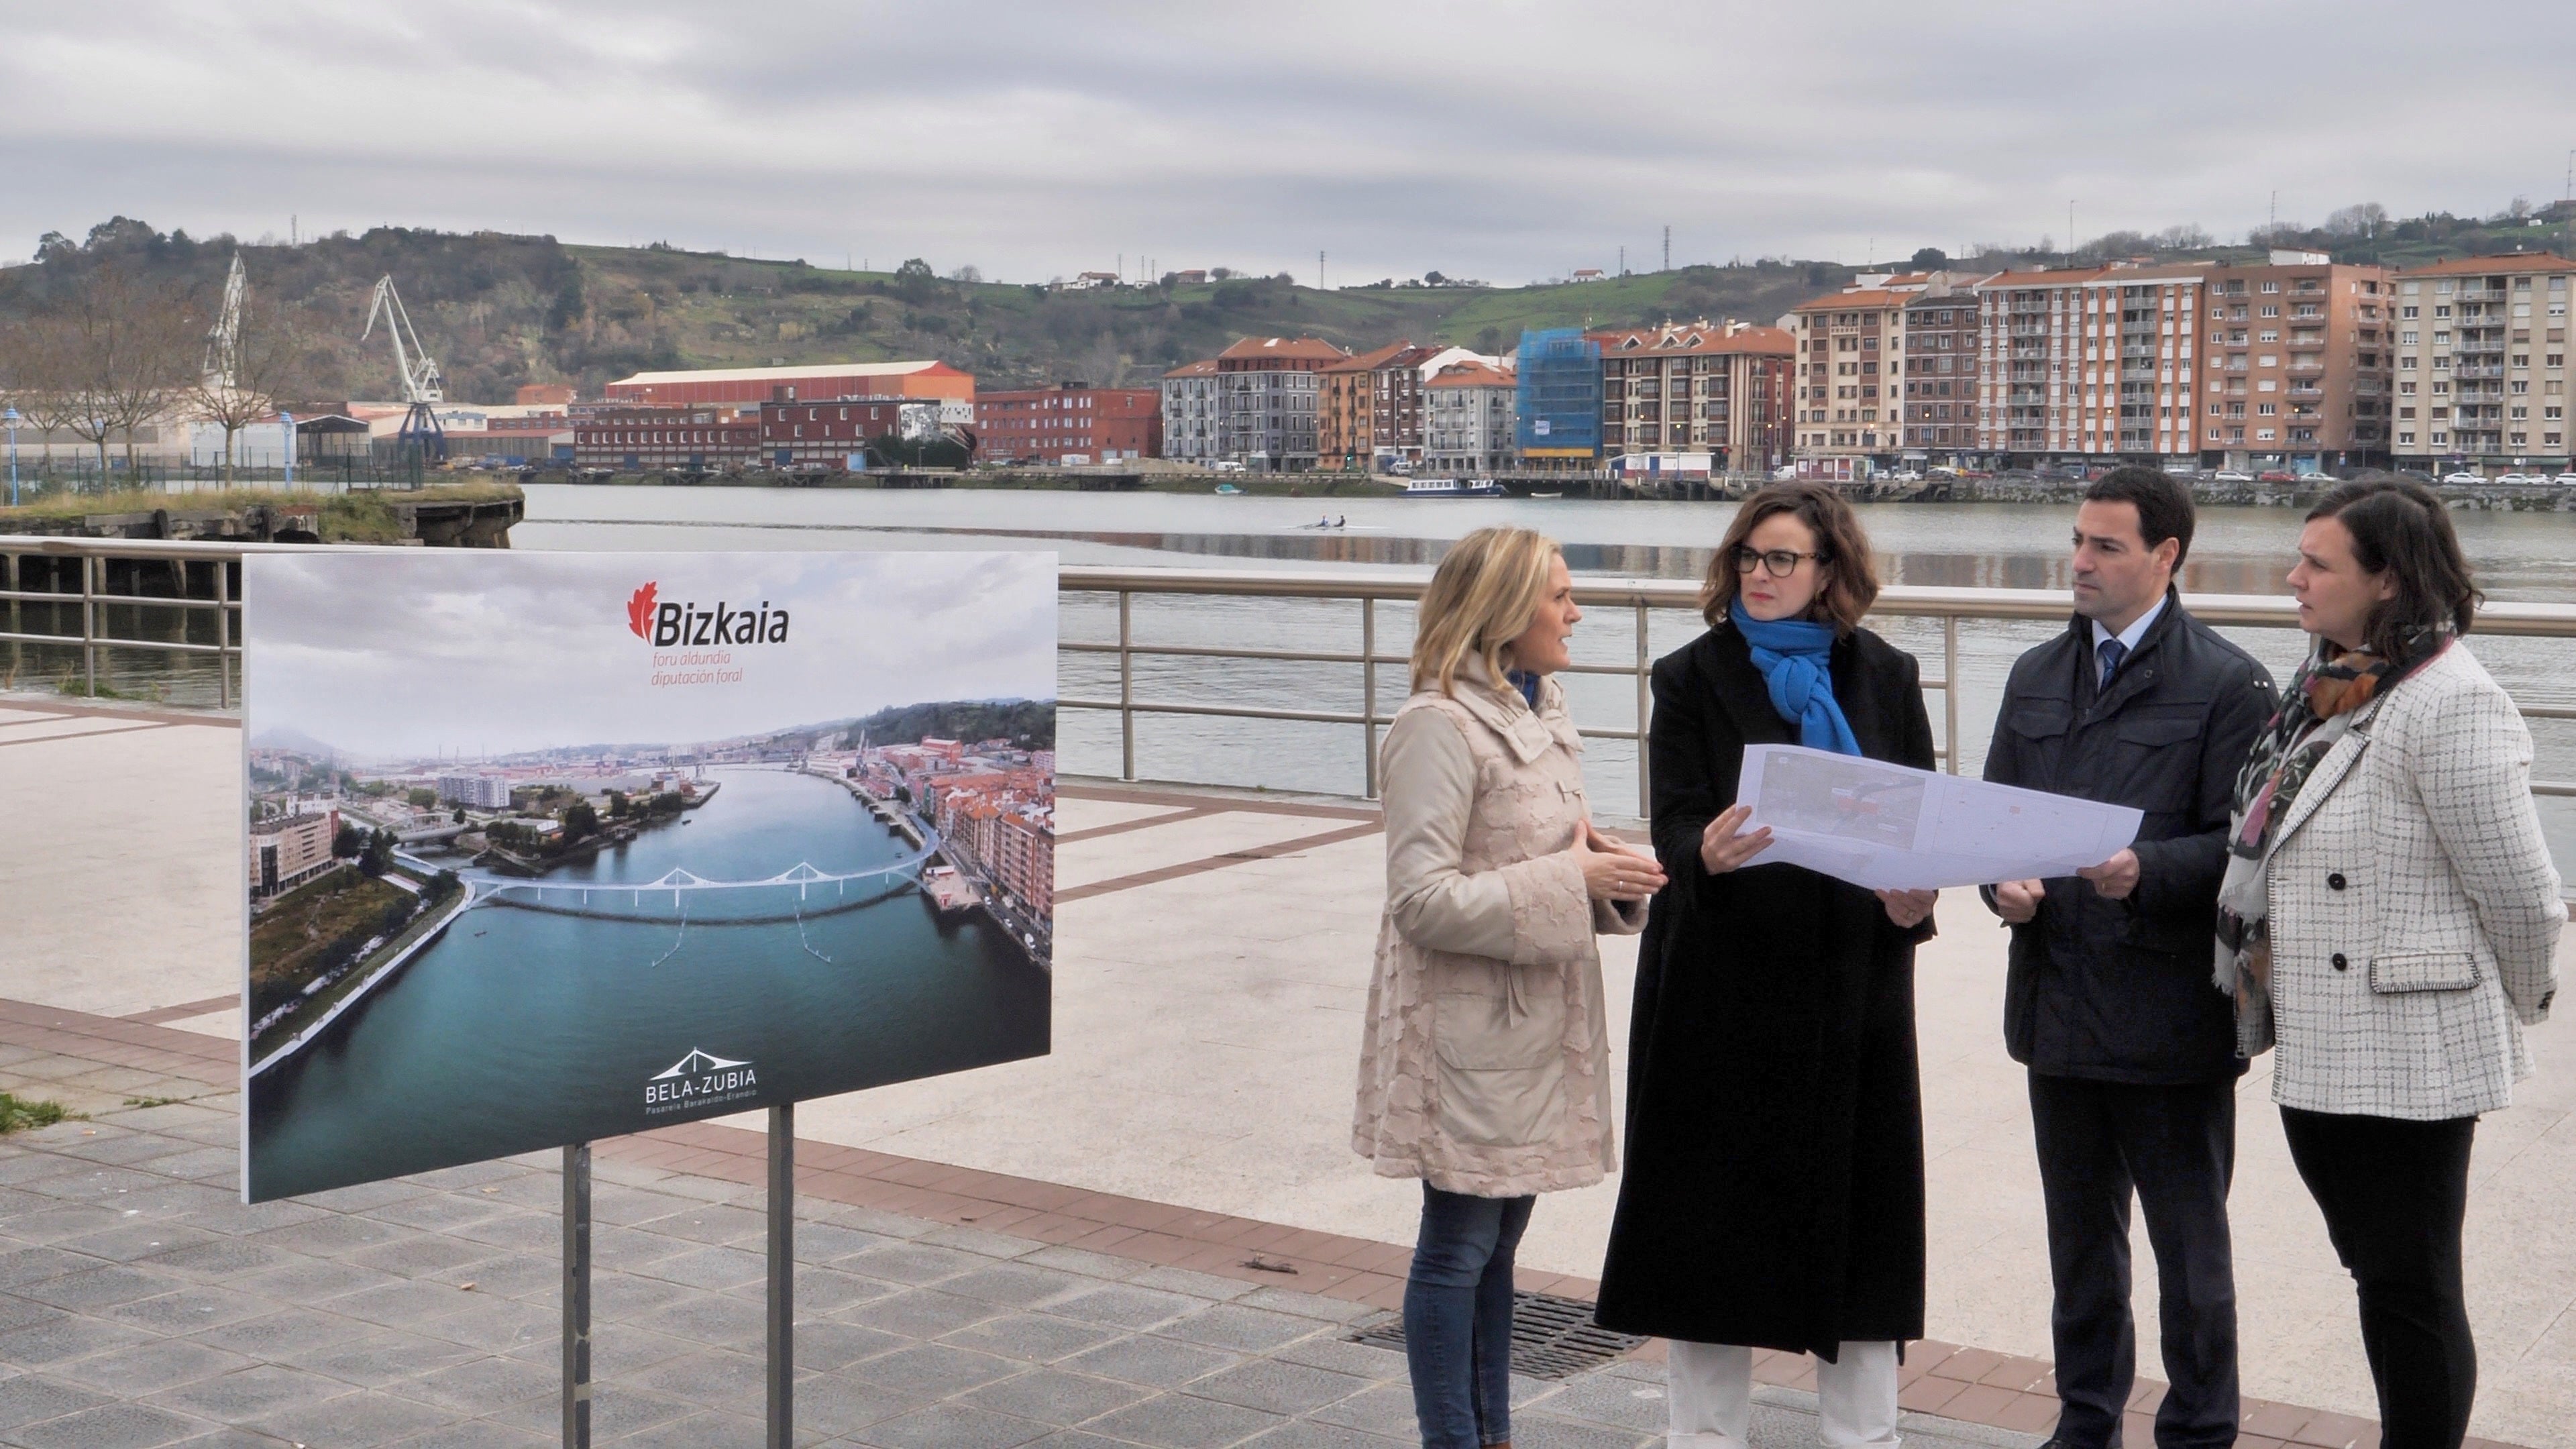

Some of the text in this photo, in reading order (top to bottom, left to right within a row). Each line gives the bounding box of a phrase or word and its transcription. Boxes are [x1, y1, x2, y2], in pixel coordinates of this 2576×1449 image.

[654, 601, 789, 647] Bizkaia
[653, 650, 731, 667] foru aldundia
[651, 667, 743, 688] diputación foral
[646, 1069, 757, 1104] BELA-ZUBIA
[646, 1103, 681, 1115] Pasarela
